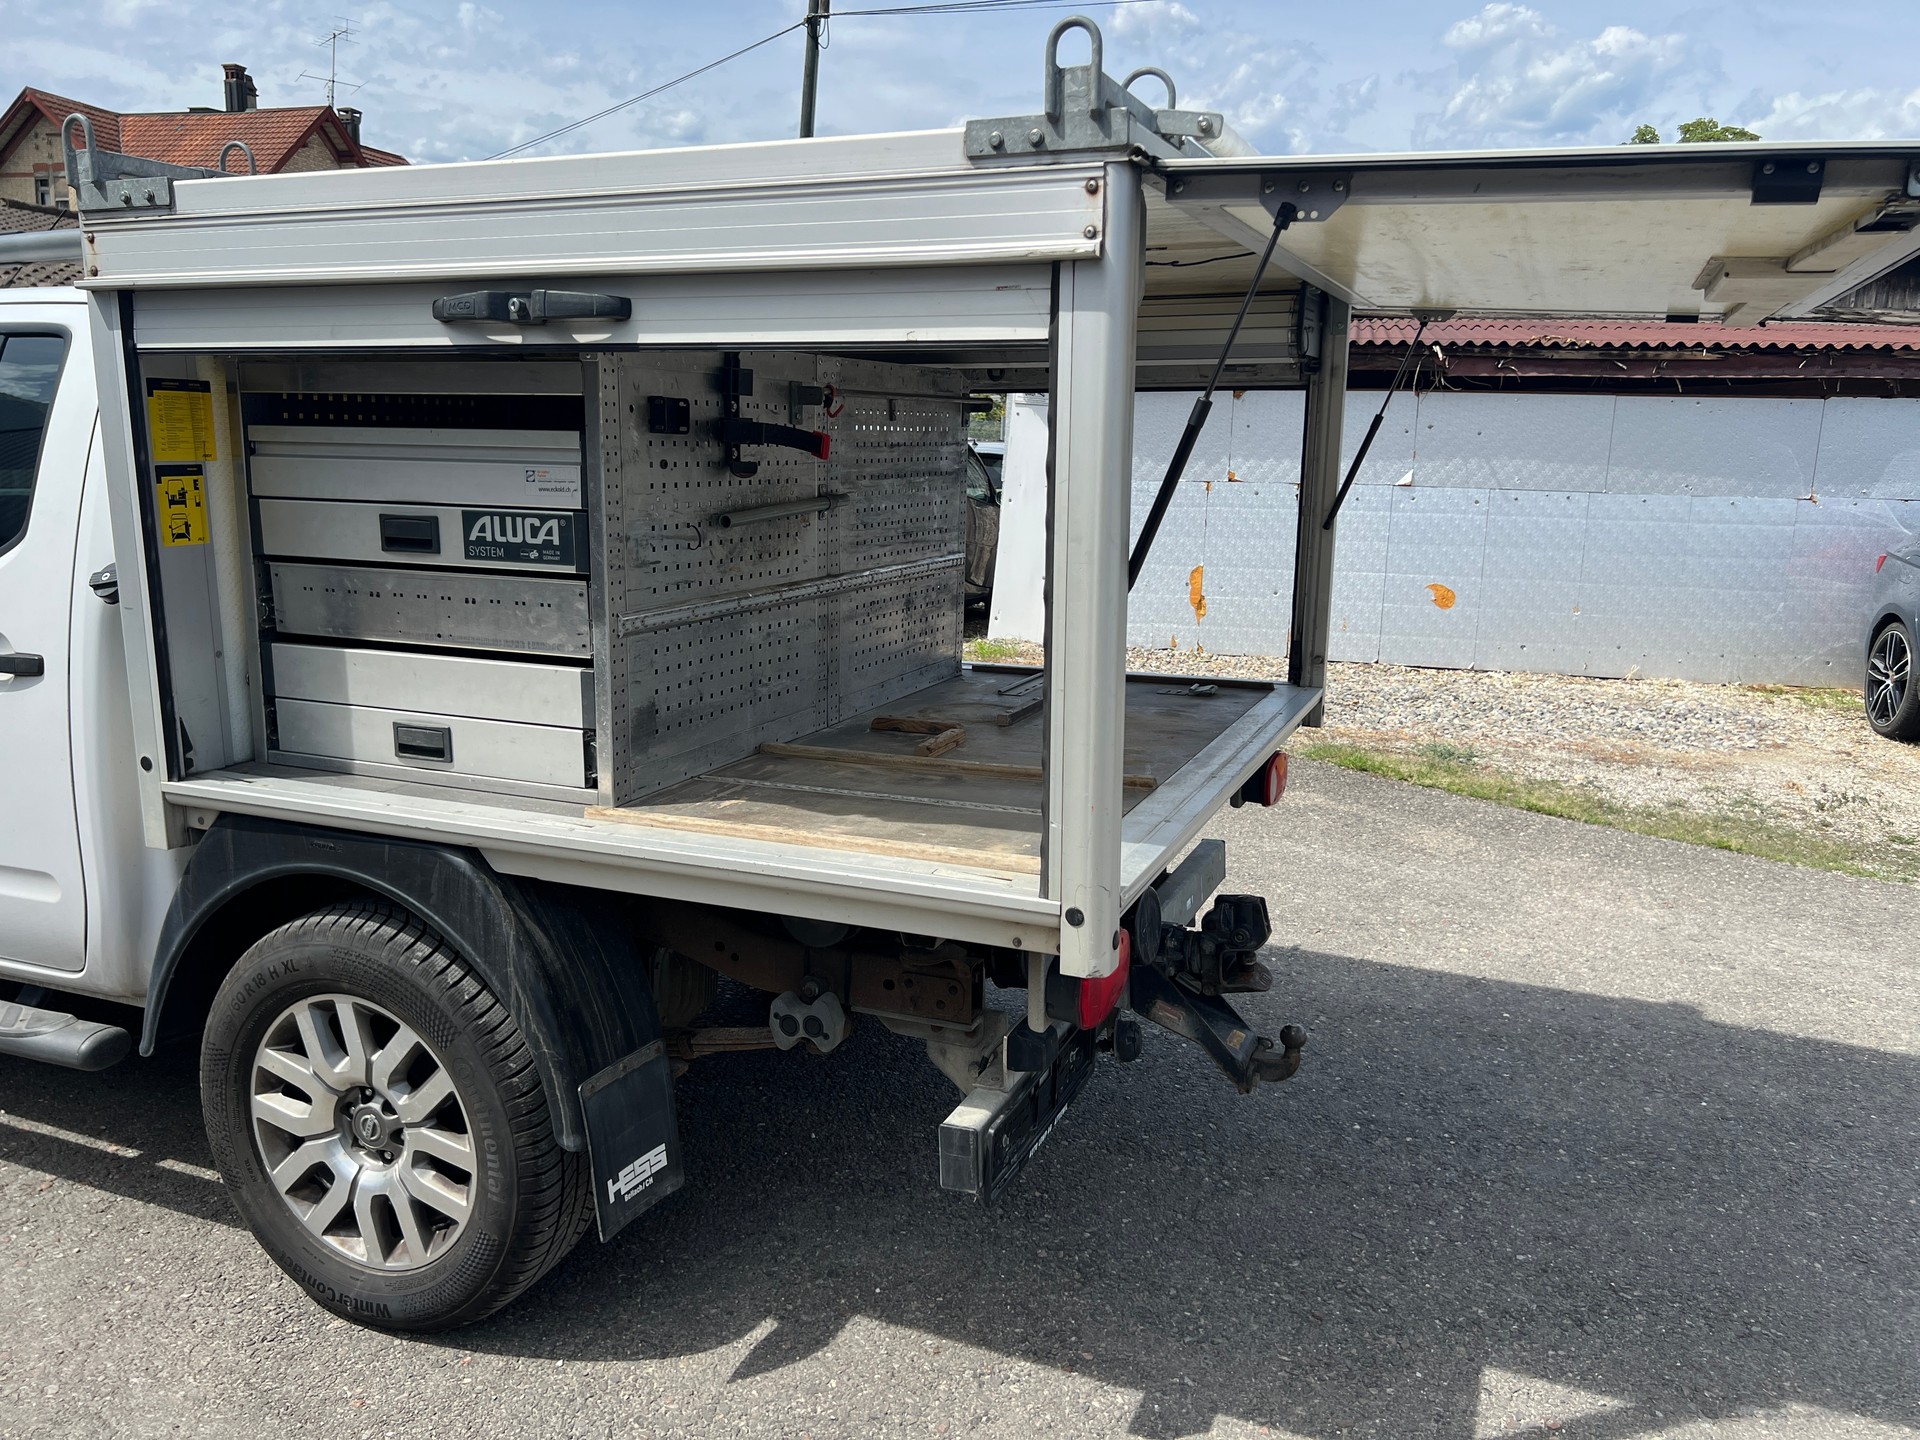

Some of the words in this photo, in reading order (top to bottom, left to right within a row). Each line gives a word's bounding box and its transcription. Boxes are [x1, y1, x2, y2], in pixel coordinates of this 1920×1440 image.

[469, 545, 505, 558] SYSTEM
[267, 965, 279, 980] H
[281, 959, 300, 975] XL
[452, 1056, 505, 1205] Continental
[607, 1142, 668, 1204] HESS
[277, 1249, 392, 1319] WinterContact
